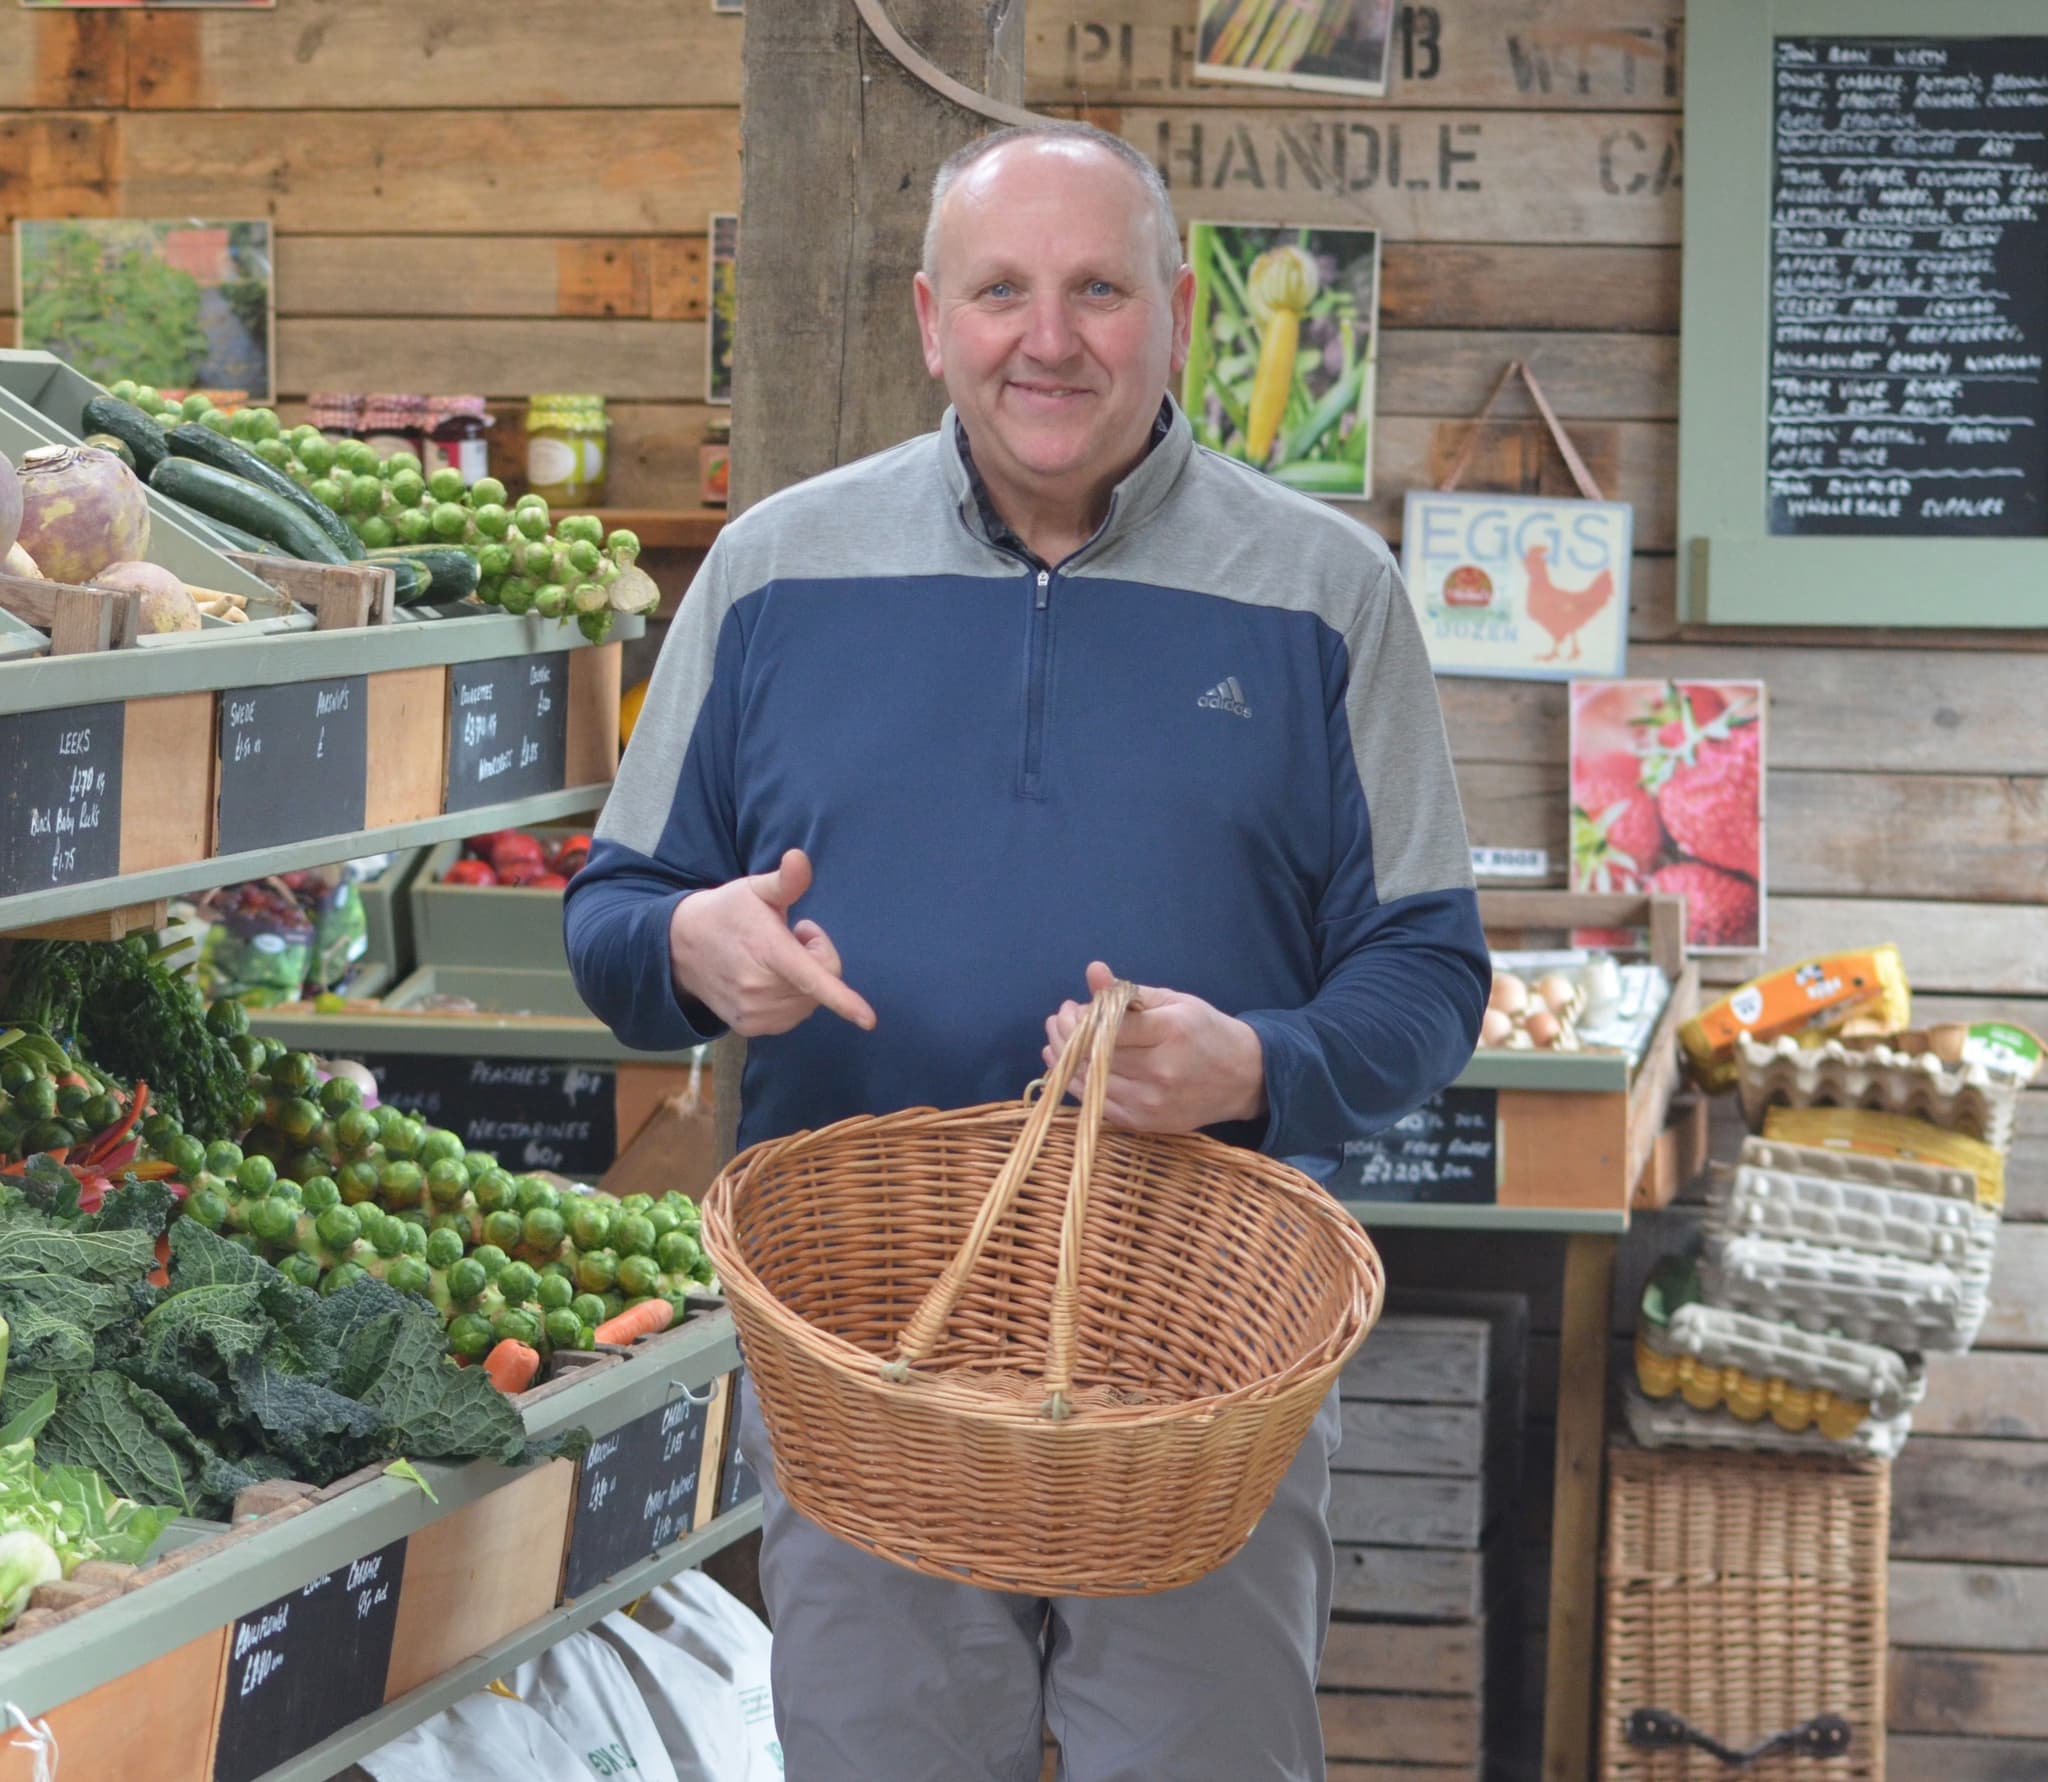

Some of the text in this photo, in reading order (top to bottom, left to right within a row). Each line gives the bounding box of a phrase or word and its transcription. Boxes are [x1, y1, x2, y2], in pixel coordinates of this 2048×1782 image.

[1158, 121, 1482, 191] HANDLE
[1421, 506, 1612, 572] EGGS
[1197, 695, 1253, 719] adidas
[59, 728, 91, 755] LEEKS
[470, 1060, 550, 1086] PEACHES
[466, 1116, 592, 1141] NECTARINES
